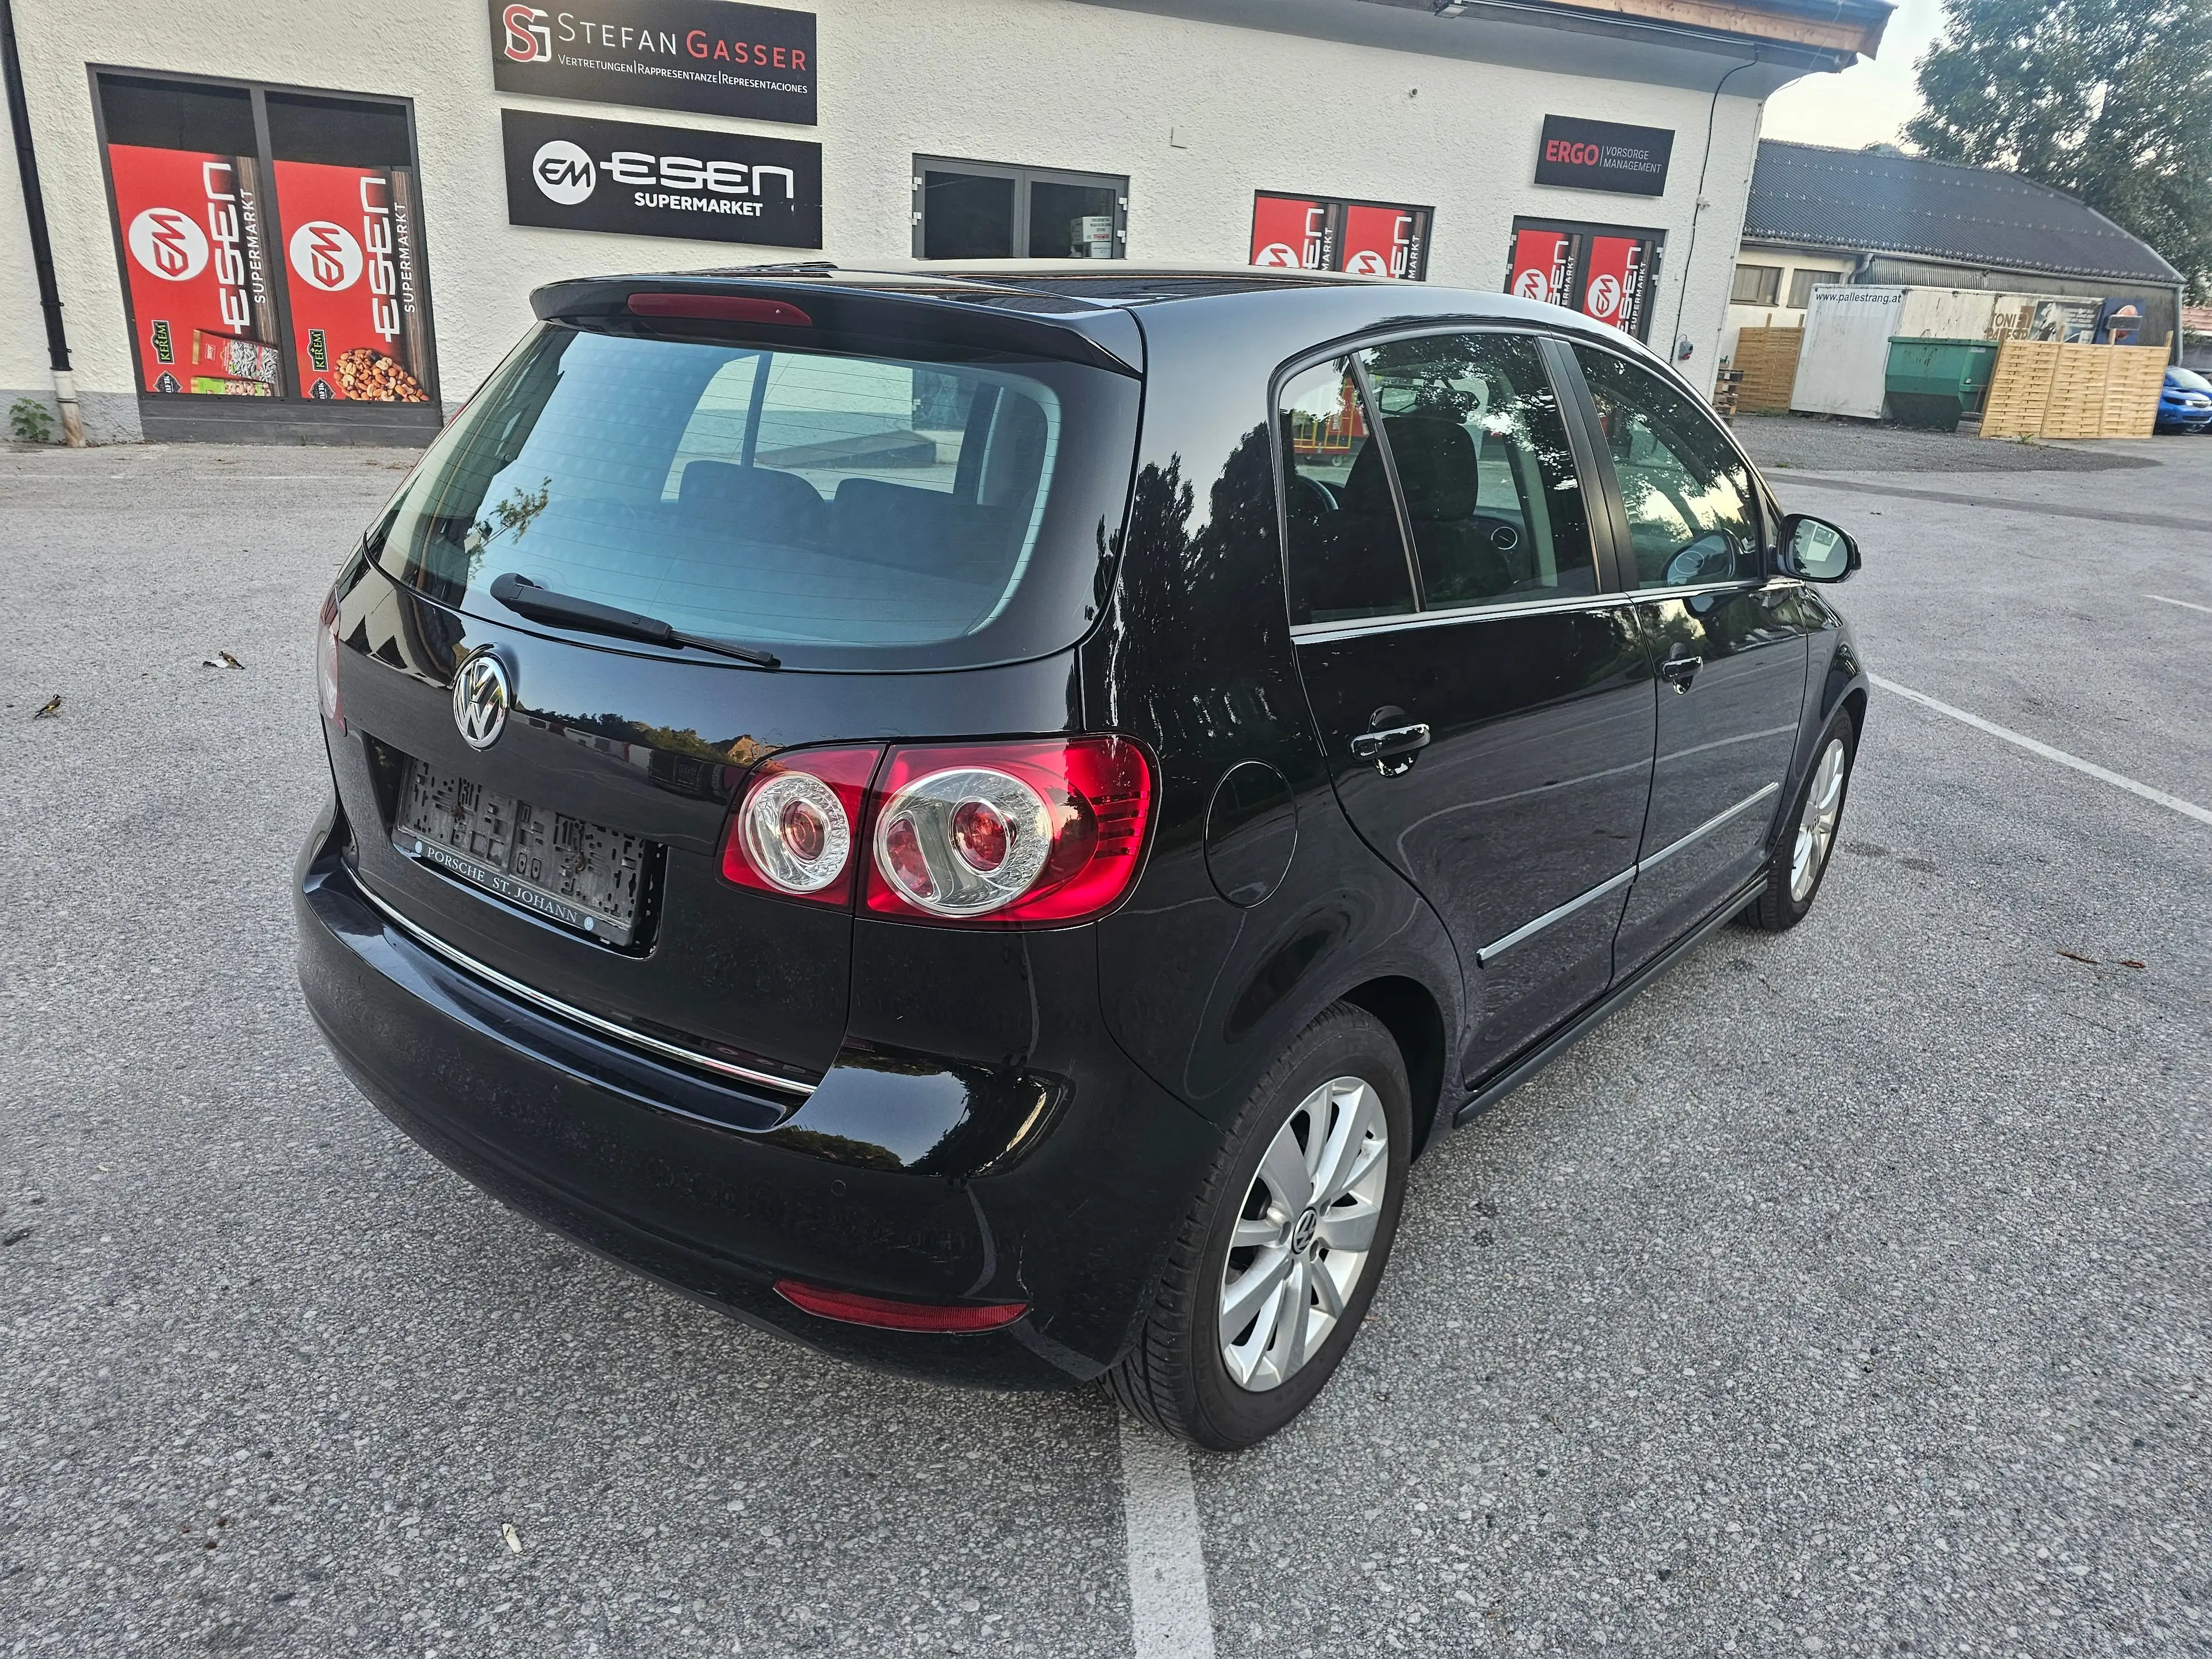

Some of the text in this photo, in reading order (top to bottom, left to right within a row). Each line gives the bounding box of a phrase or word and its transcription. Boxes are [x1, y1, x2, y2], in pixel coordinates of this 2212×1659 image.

[557, 12, 806, 70] STEFAN GASSER
[1546, 139, 1599, 165] ERGO
[1603, 158, 1662, 173] MANAGEMENT
[1605, 146, 1650, 160] VORSORGE
[634, 191, 763, 217] SUPERMARKET
[240, 188, 266, 304] SUPERMARKT
[394, 202, 415, 313] SUPERMARKT
[1321, 228, 1333, 271] MARKT
[1408, 235, 1420, 279] MARKT
[1562, 256, 1574, 305] ERMARKT
[1630, 262, 1646, 330] SUPERMARKT
[1816, 292, 1902, 305] www.pallestrang.at
[156, 323, 171, 361] KEREM
[313, 332, 325, 368] KEREM
[427, 846, 578, 923] PORSCHE ST. JOHANN
